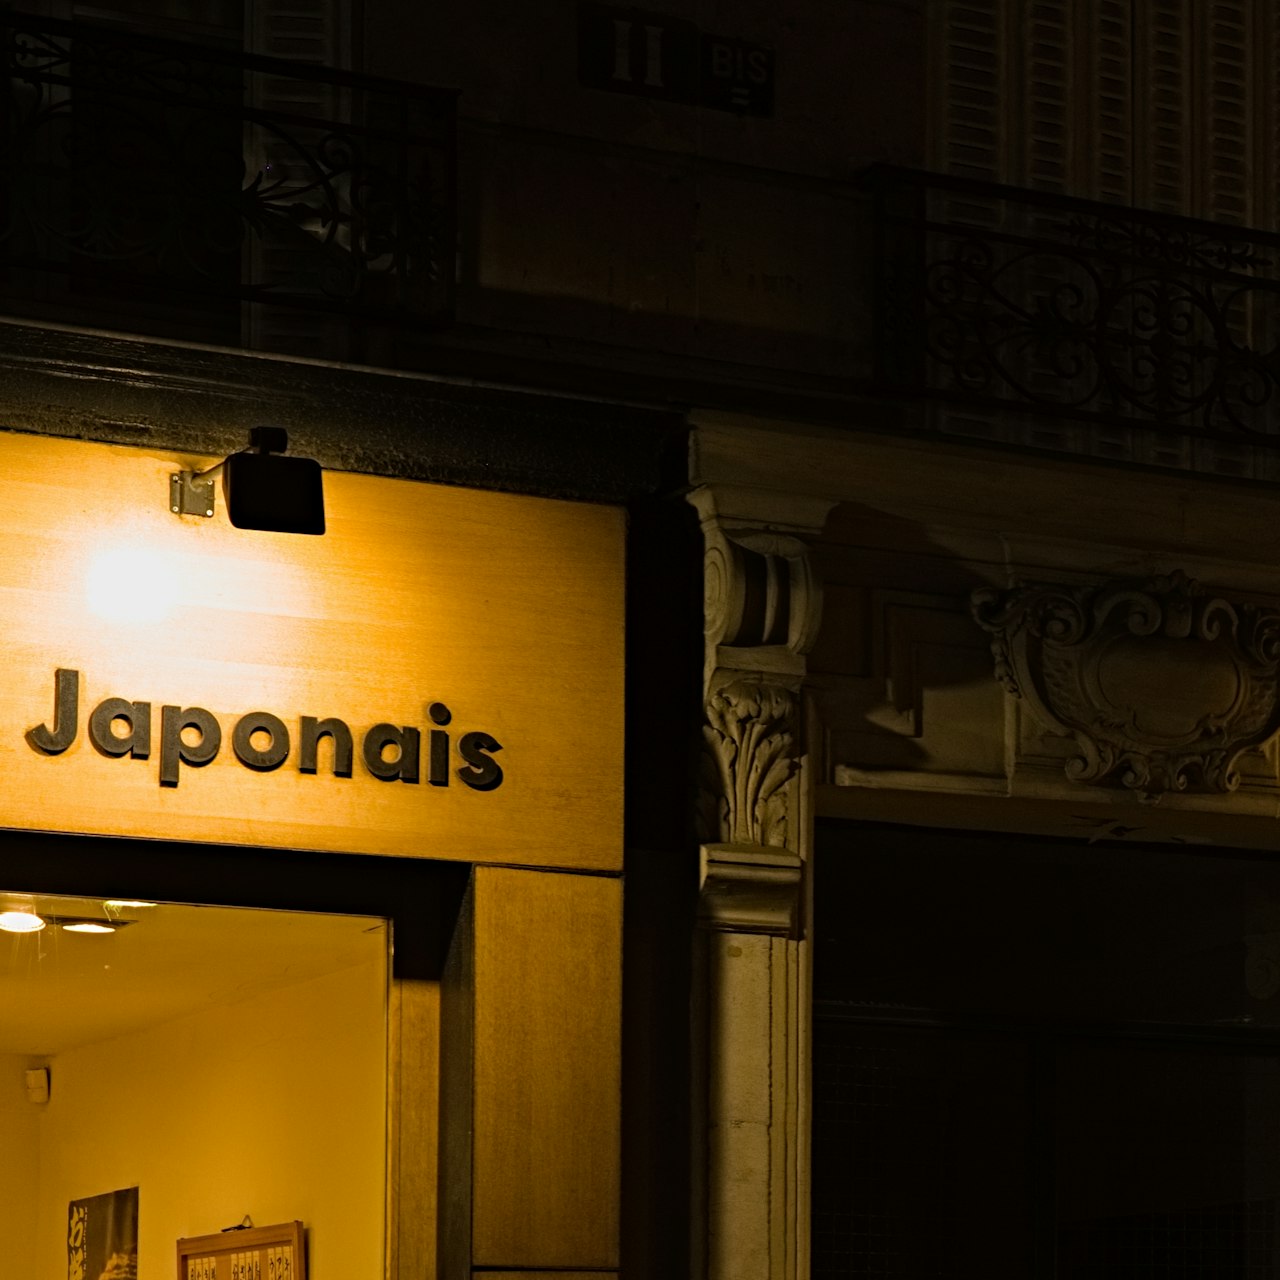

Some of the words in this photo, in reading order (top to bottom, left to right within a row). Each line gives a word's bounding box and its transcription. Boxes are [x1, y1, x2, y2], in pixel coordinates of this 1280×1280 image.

[612, 19, 664, 87] 11
[712, 43, 768, 84] BIS
[25, 667, 505, 792] Japonais
